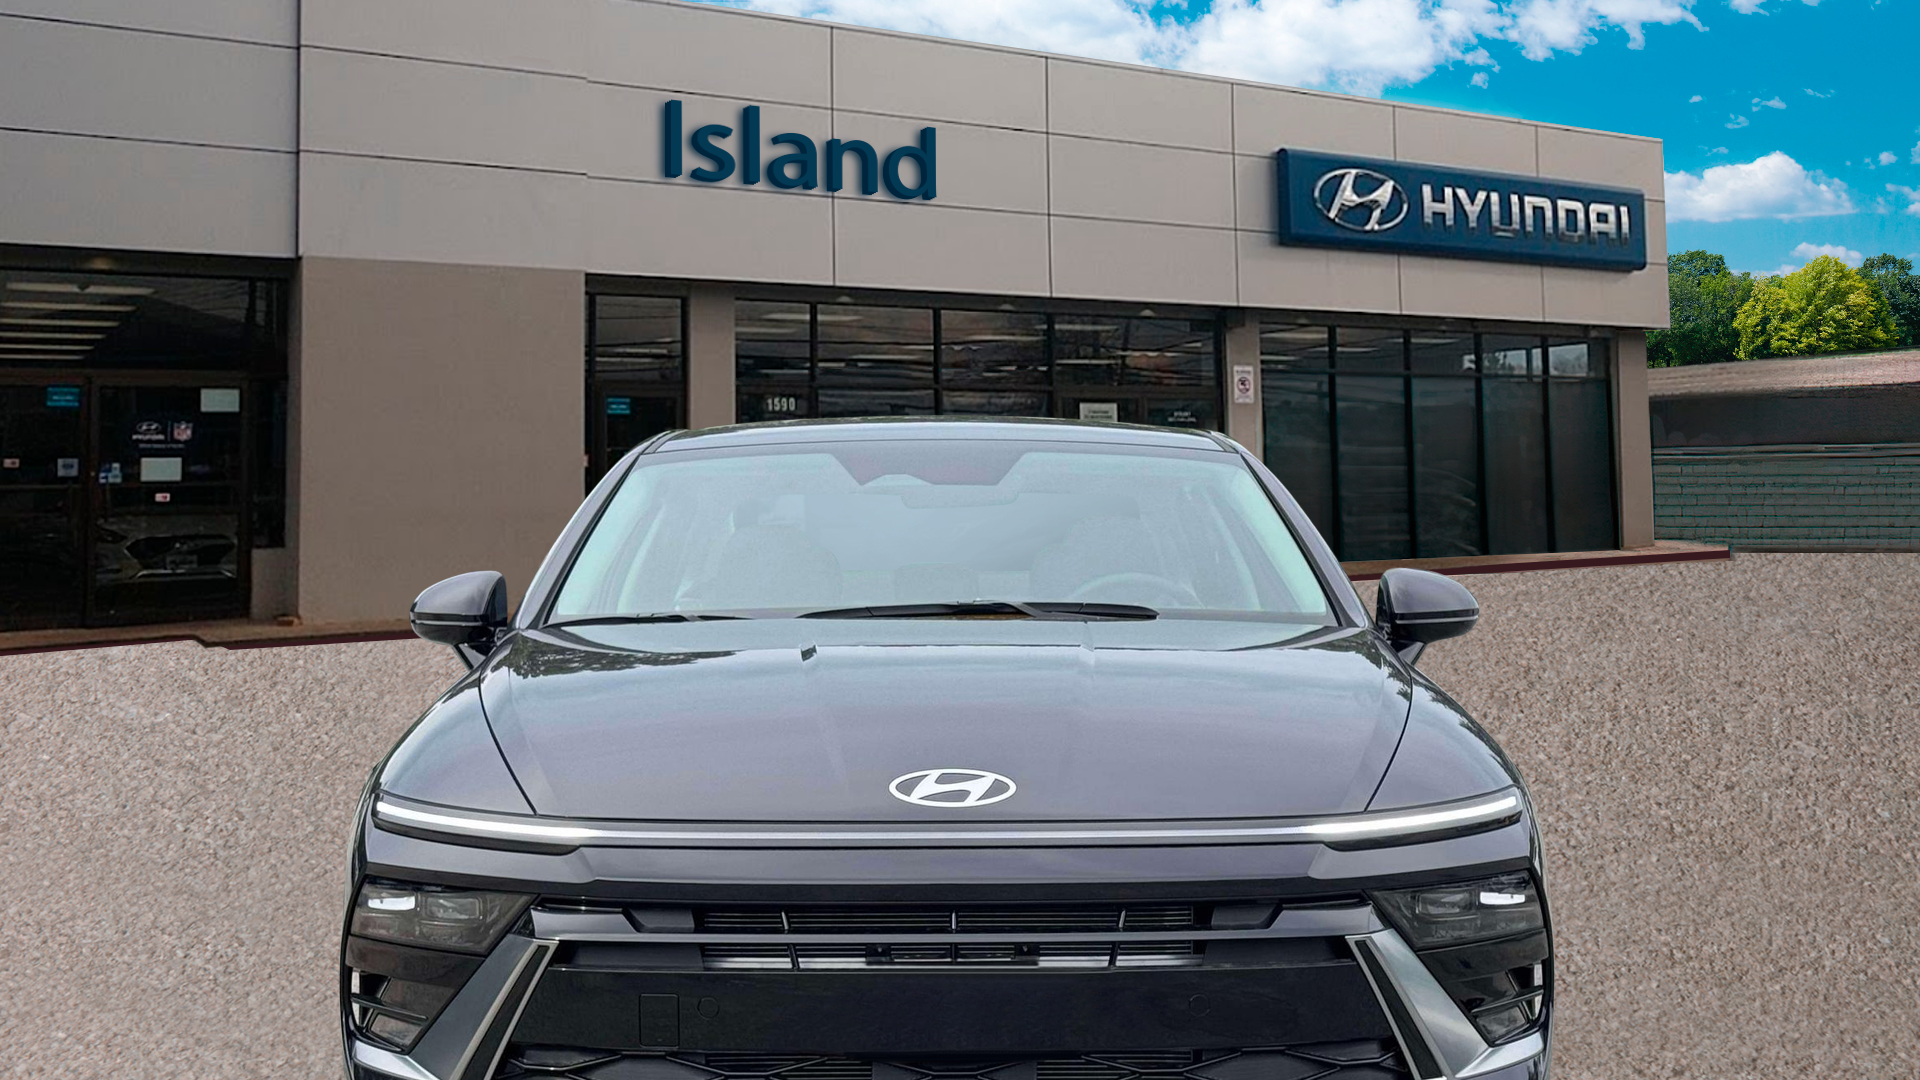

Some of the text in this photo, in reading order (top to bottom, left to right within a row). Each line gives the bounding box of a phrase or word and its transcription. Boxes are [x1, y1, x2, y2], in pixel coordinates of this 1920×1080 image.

[664, 99, 937, 201] Island
[1421, 183, 1631, 245] HYUNDAI
[767, 397, 796, 411] 1590
